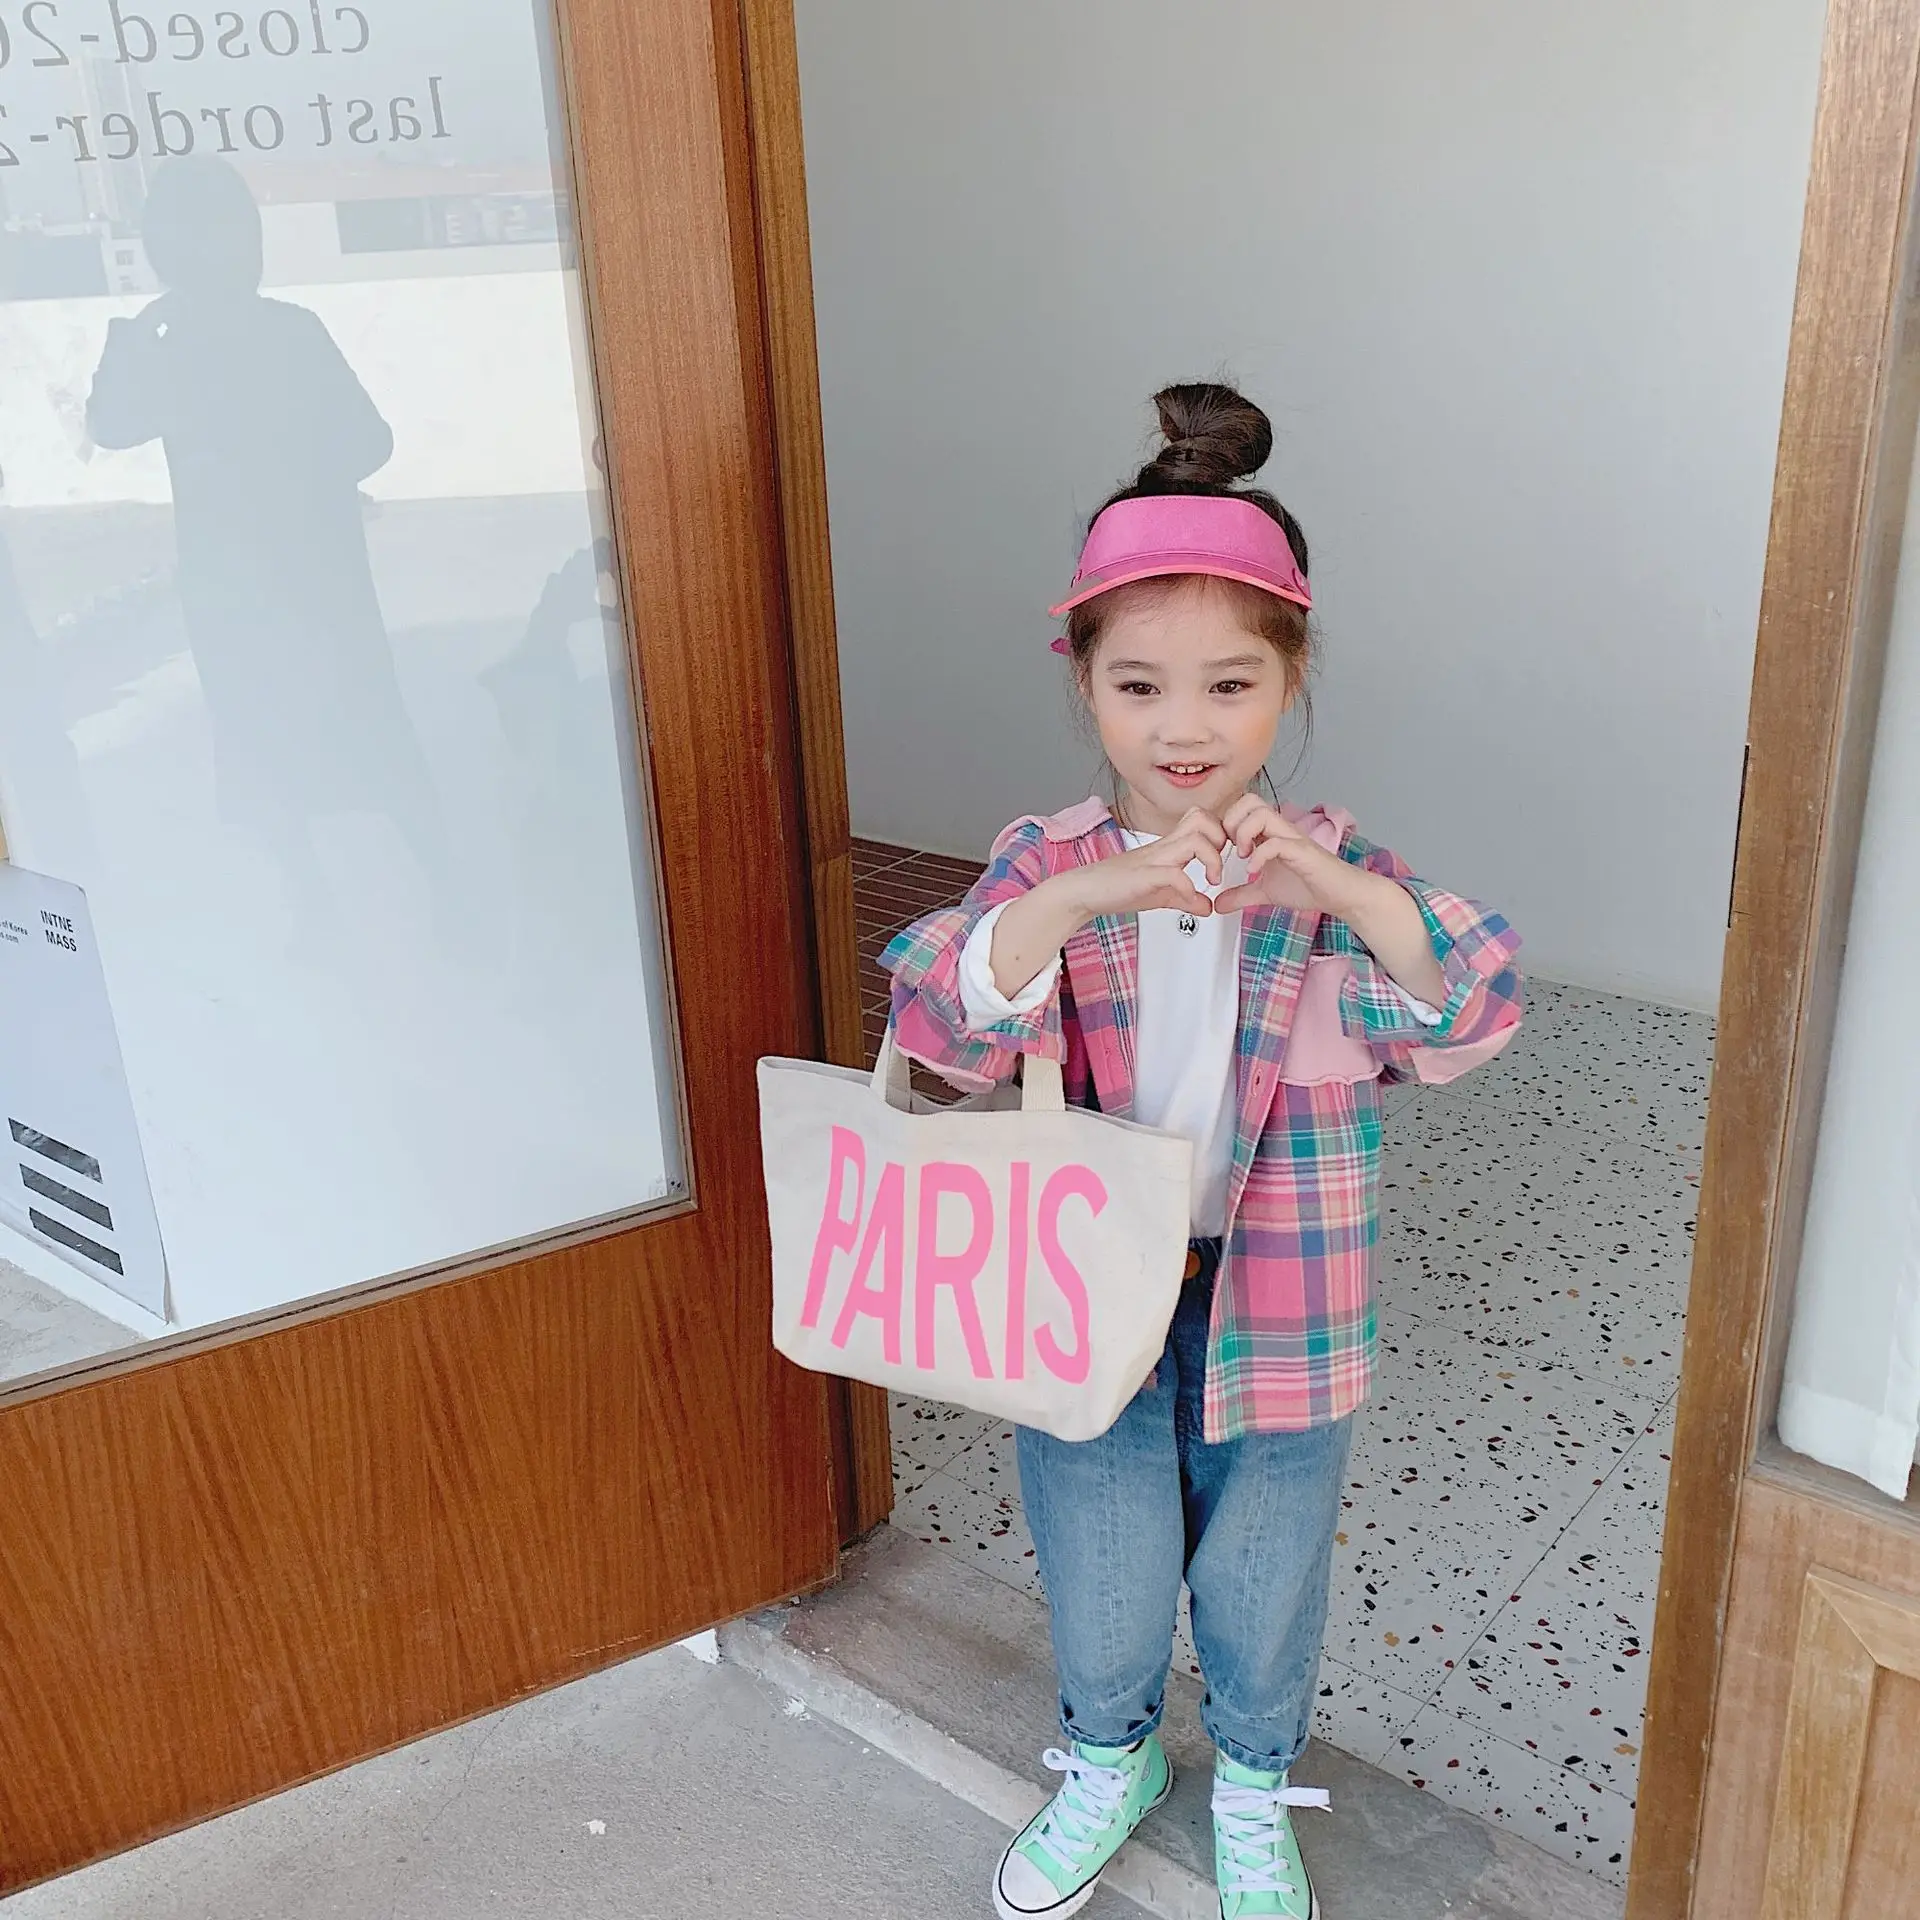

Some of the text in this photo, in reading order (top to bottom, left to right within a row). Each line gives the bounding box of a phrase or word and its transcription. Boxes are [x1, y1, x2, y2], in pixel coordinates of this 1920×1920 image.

[40, 909, 74, 933] INTNE
[45, 929, 77, 952] MASS
[799, 1125, 1108, 1384] PARIS
